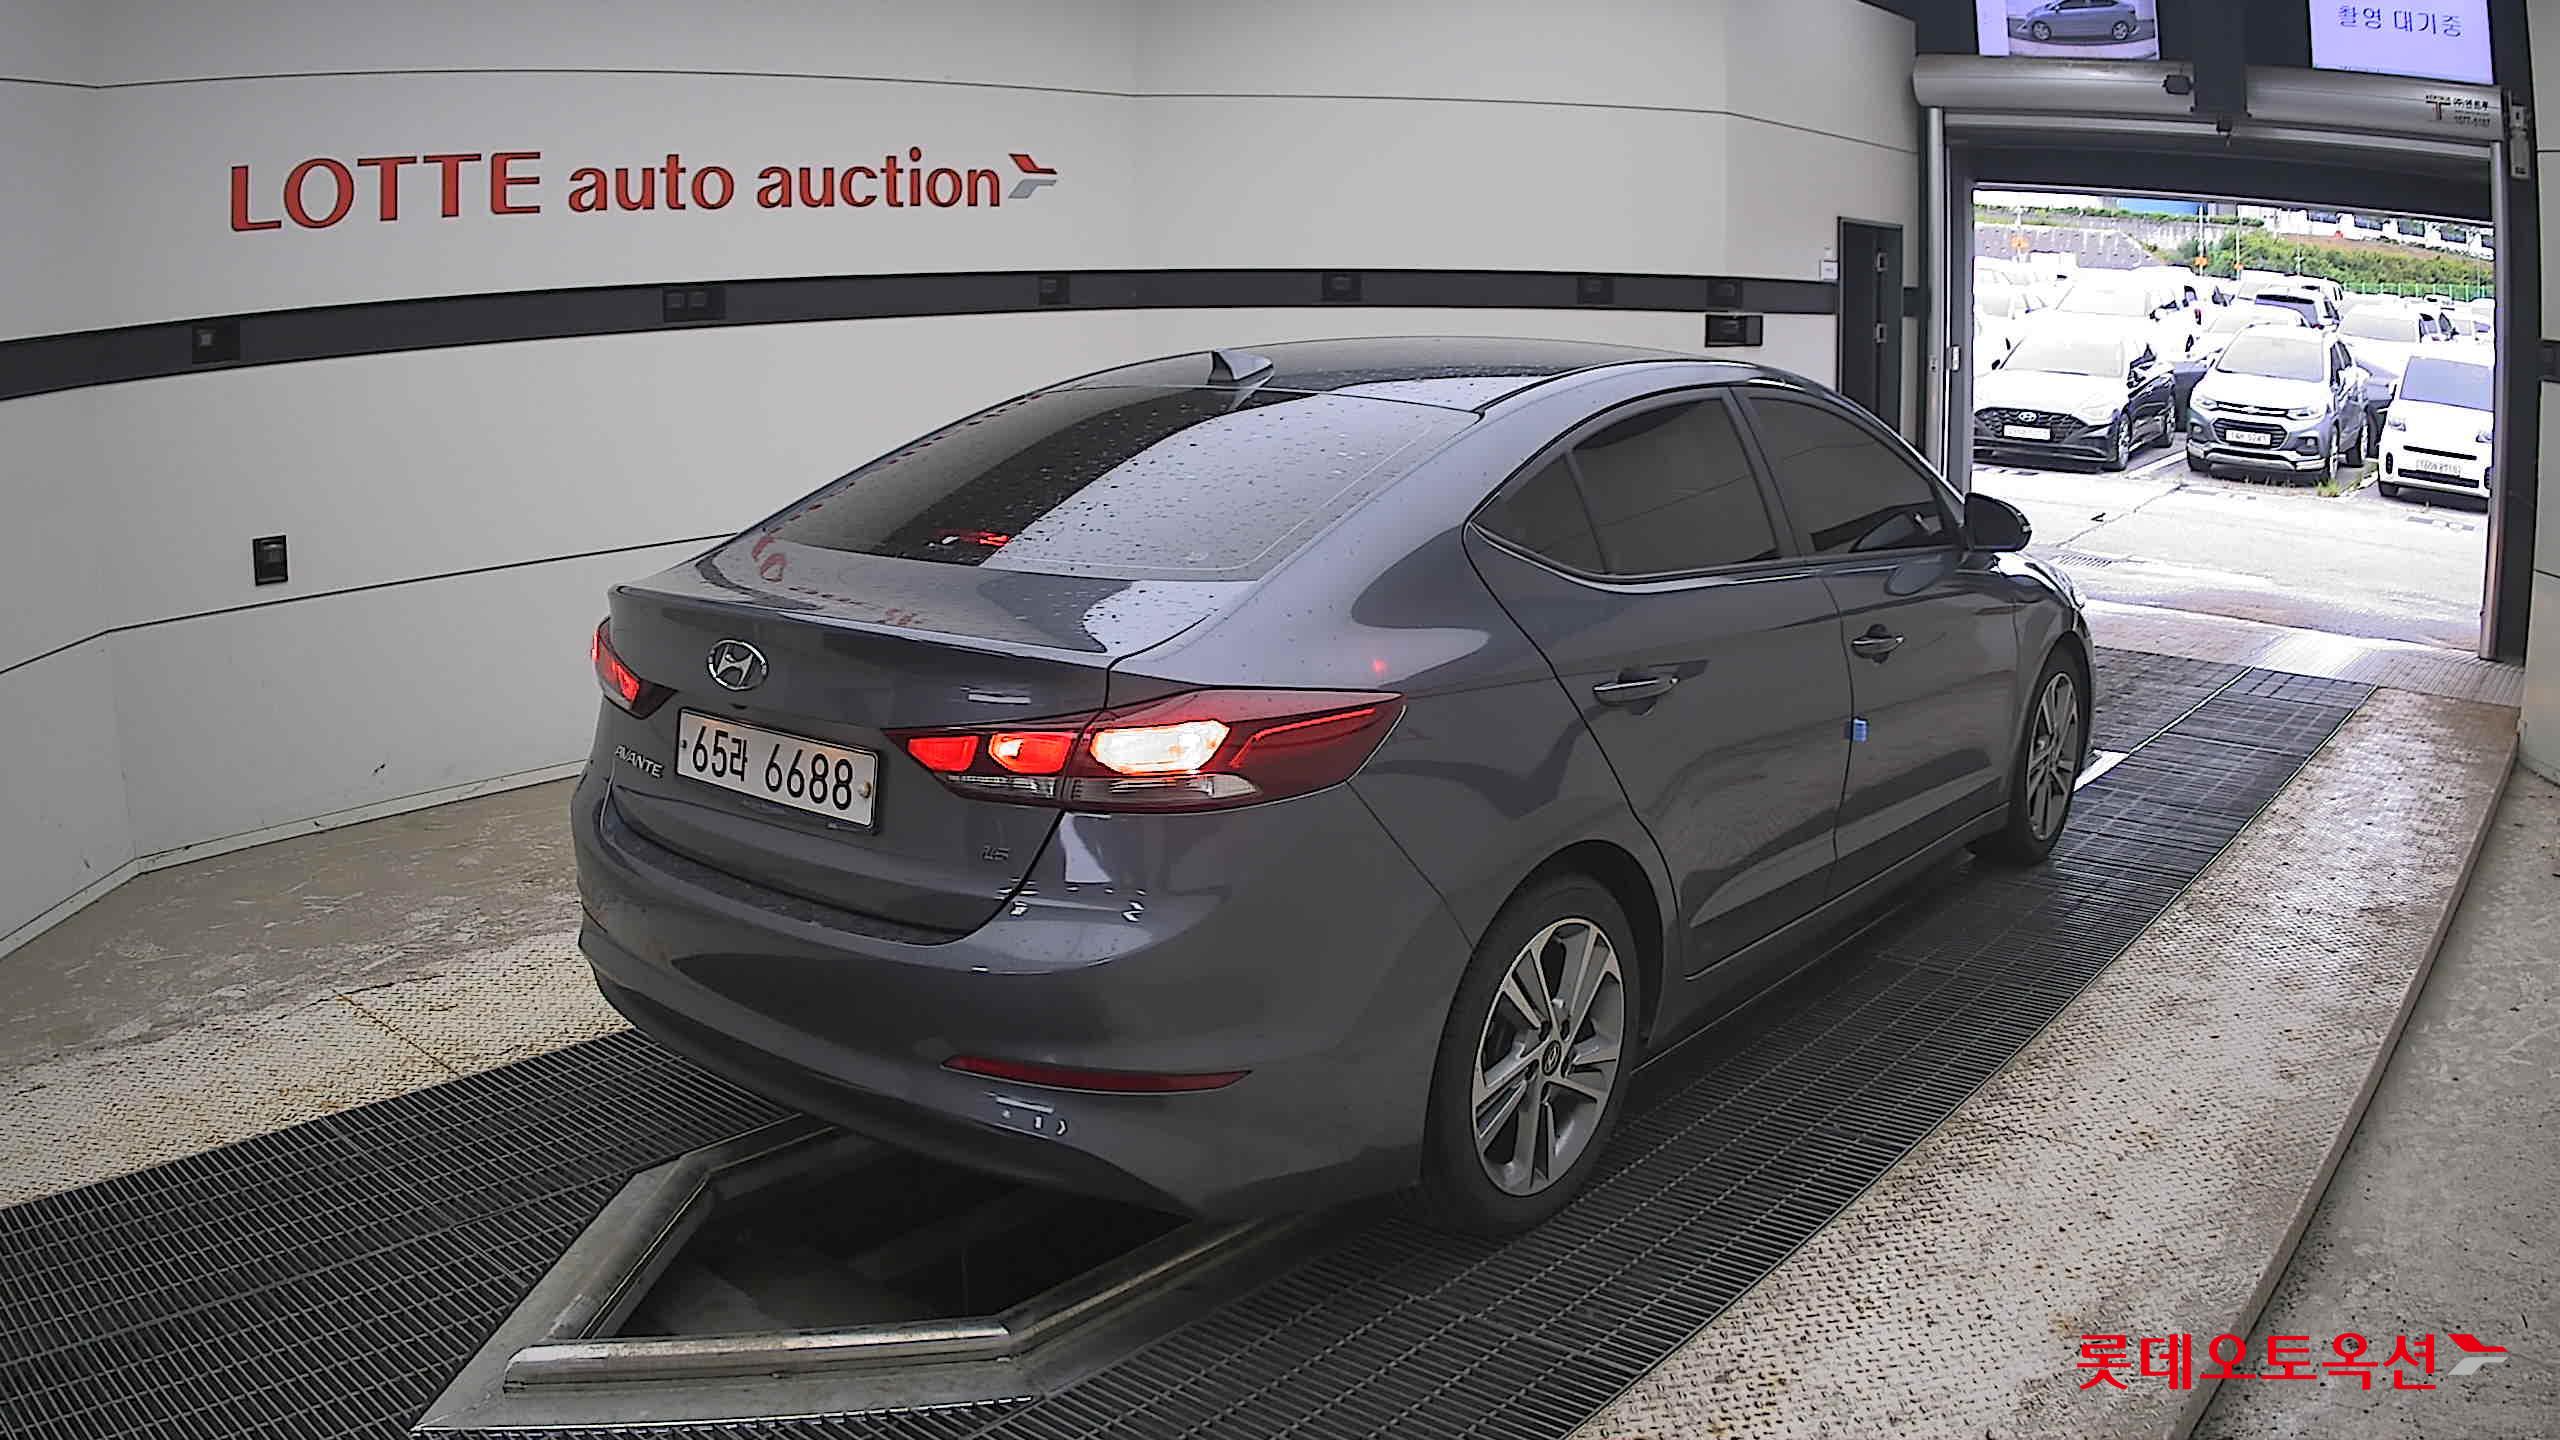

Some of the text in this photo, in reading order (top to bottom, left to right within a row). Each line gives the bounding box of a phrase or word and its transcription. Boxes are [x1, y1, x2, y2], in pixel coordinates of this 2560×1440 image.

[2339, 5, 2462, 38] 촬영 대기중
[230, 147, 1001, 232] LOTTE auto auction
[615, 744, 664, 779] AVANTE
[692, 725, 854, 811] 65라 6688
